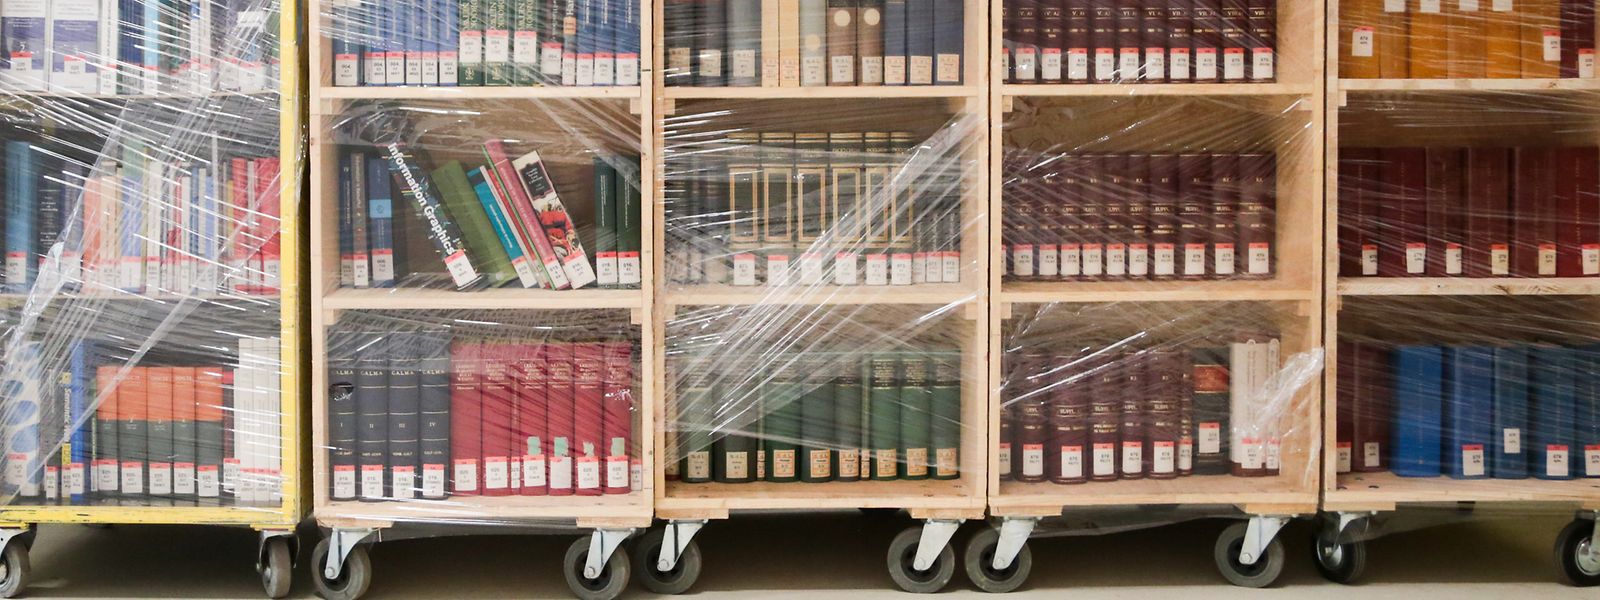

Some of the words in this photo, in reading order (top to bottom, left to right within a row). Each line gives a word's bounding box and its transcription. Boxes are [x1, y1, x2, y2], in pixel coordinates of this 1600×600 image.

[386, 141, 429, 206] Information
[421, 203, 458, 256] Graphics
[64, 388, 72, 424] Semantic
